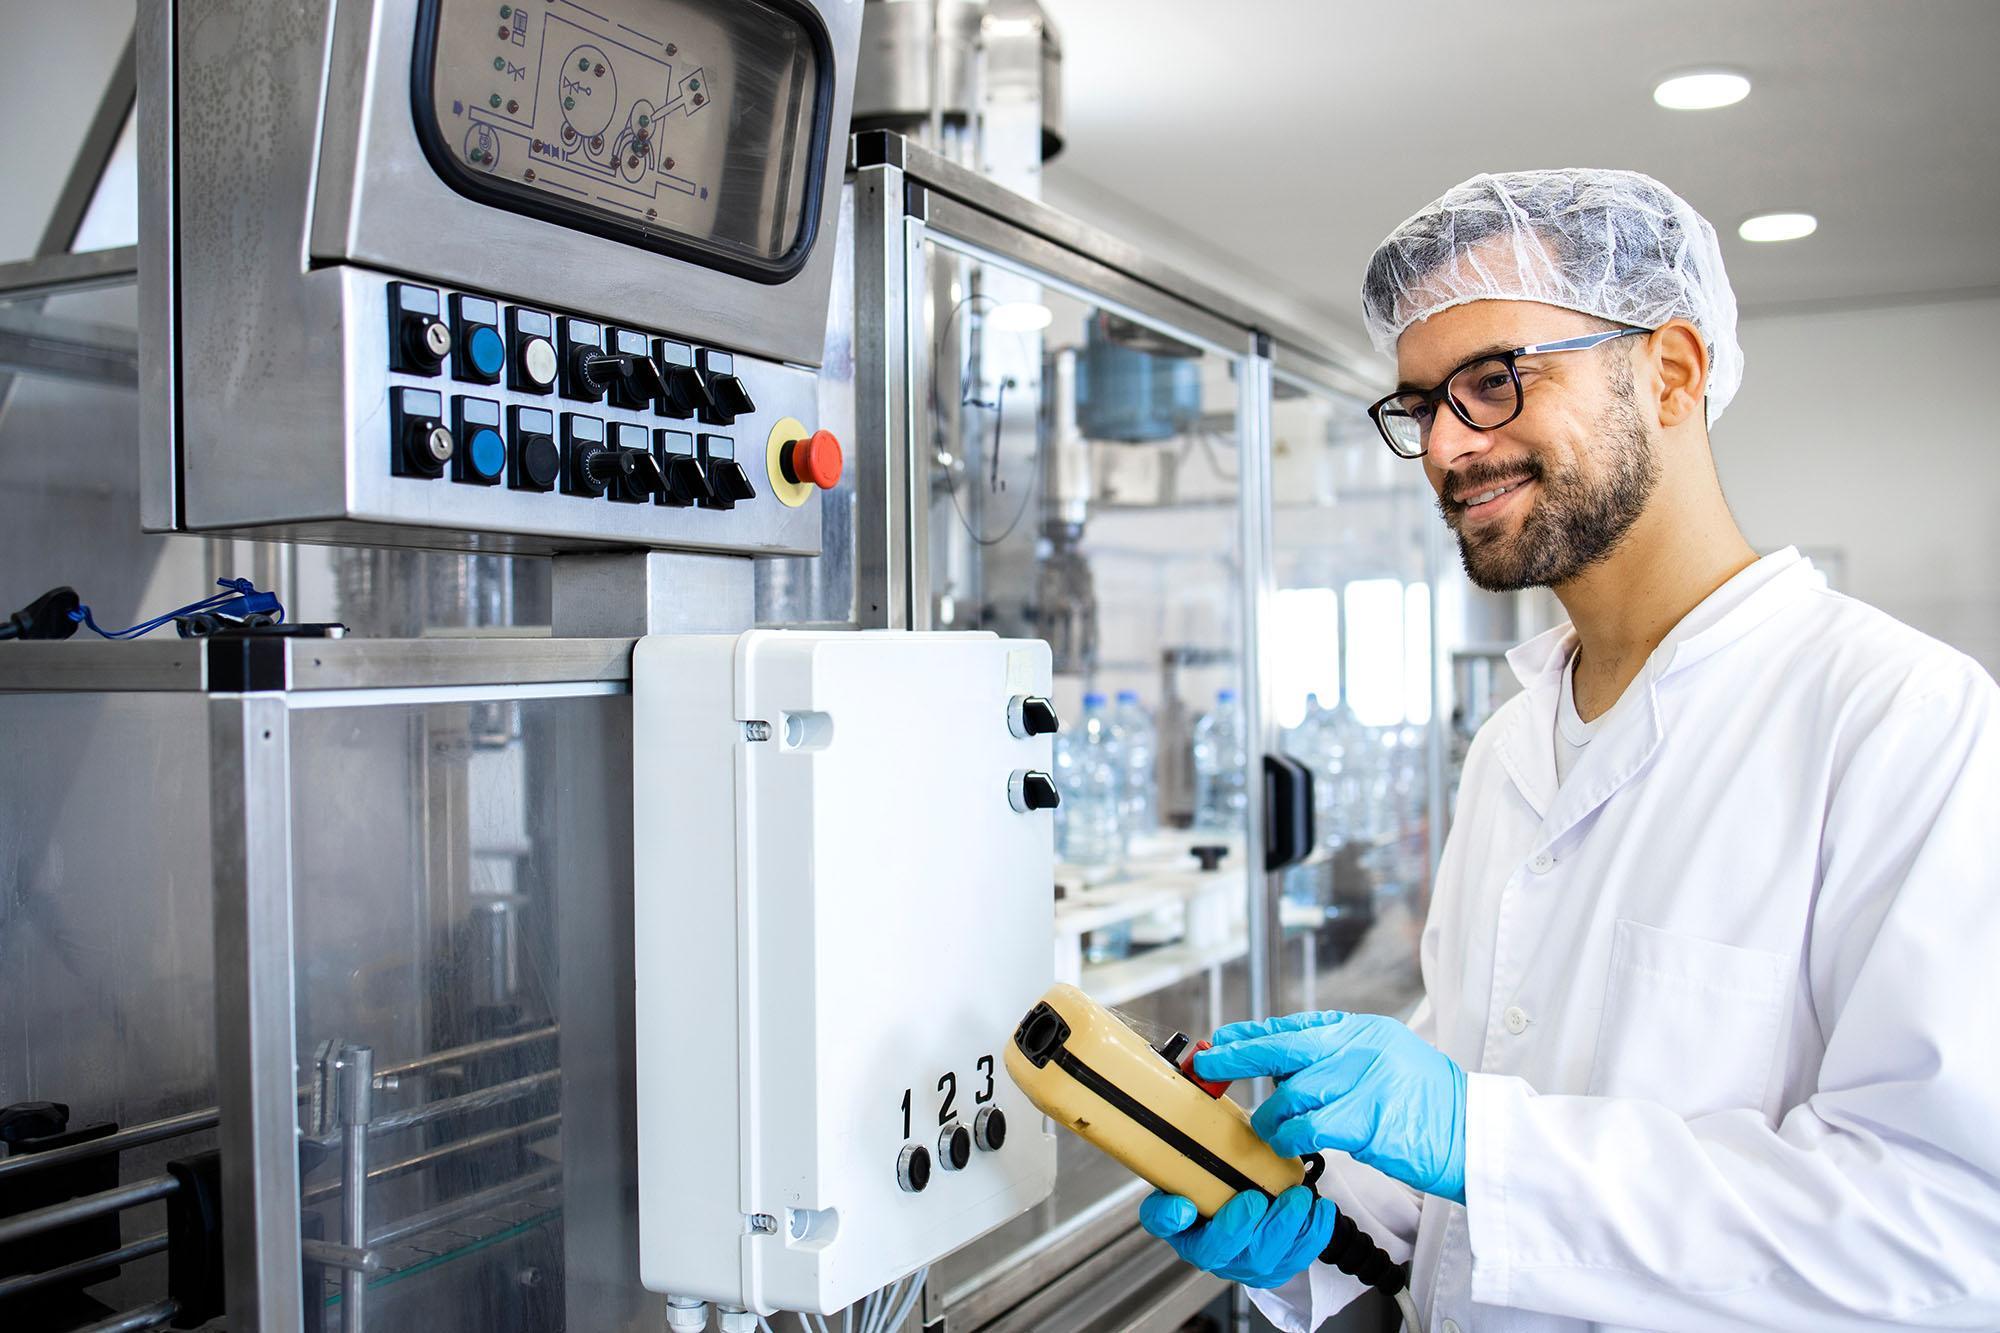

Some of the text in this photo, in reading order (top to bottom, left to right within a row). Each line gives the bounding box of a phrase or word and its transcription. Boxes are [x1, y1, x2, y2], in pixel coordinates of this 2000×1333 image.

[901, 1054, 994, 1140] 1 2 3
